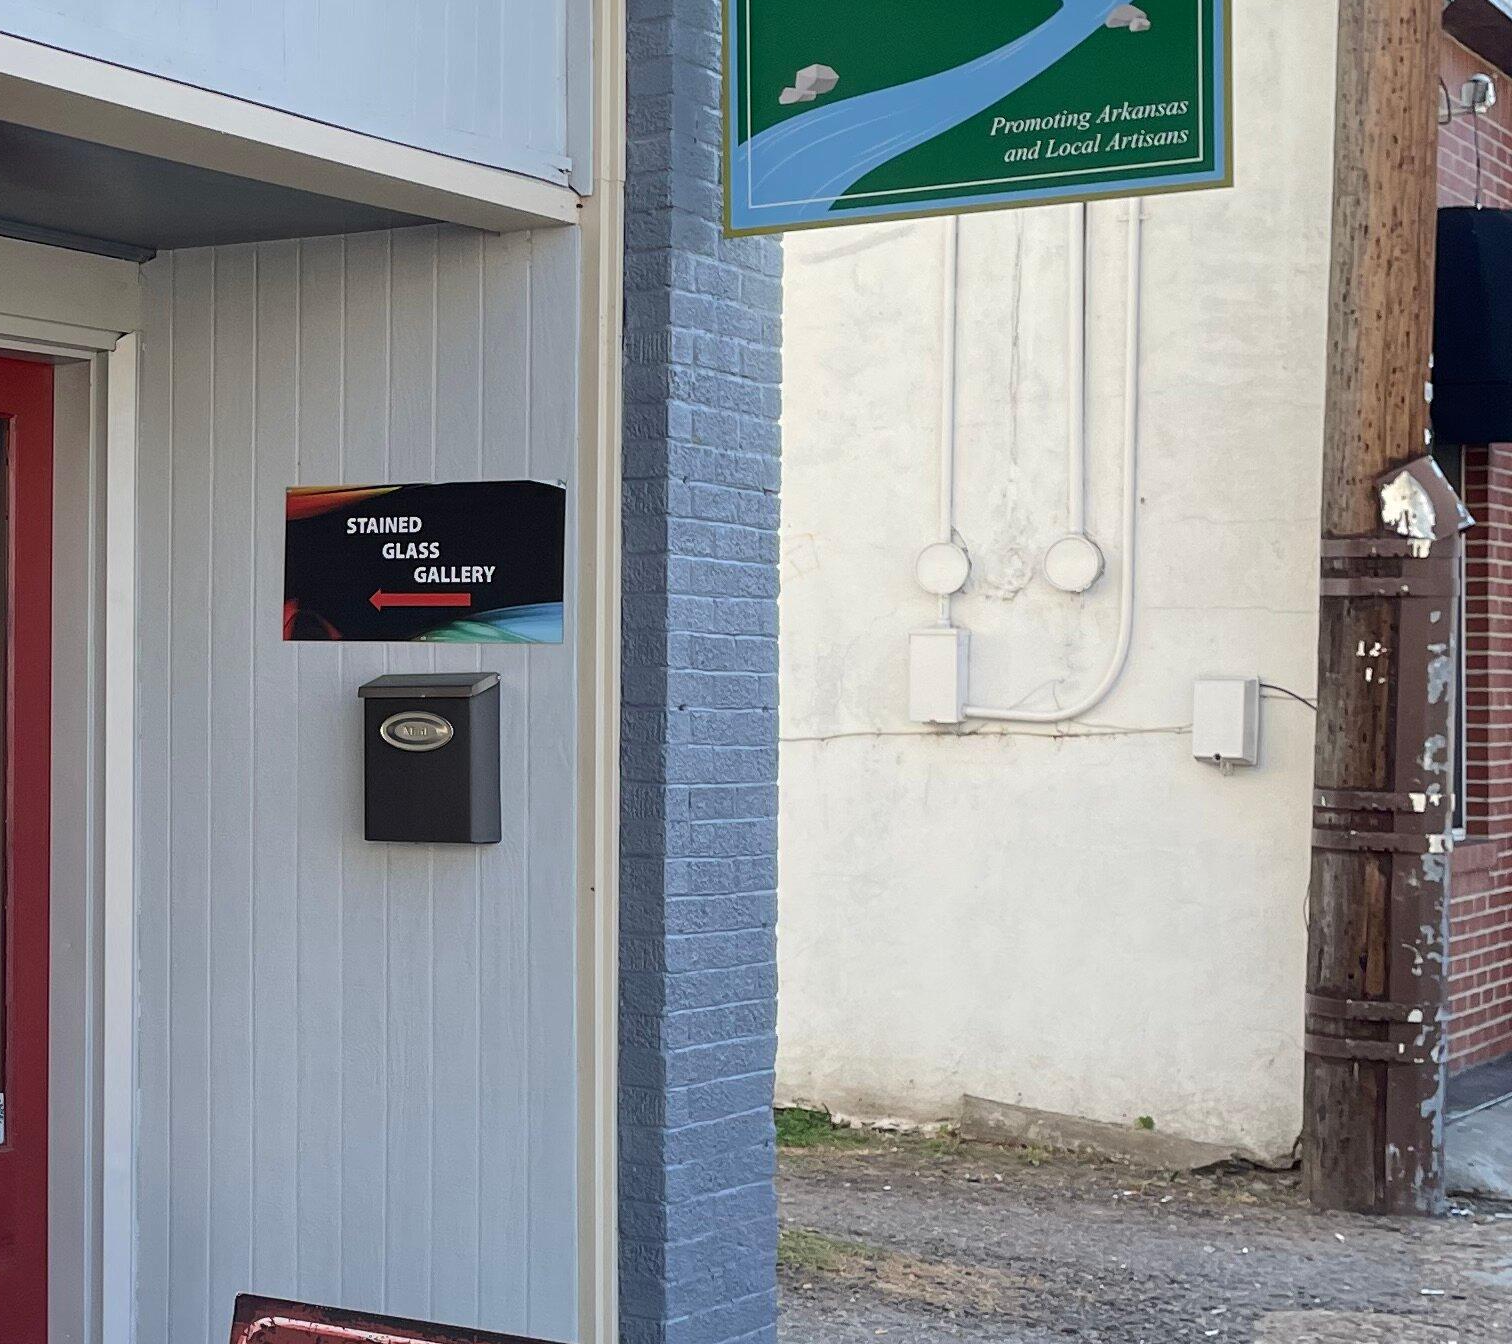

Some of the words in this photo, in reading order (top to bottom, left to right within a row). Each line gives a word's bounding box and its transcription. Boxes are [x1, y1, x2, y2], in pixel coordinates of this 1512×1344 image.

[990, 110, 1091, 137] Promoting
[1096, 99, 1189, 123] Arkansas
[1004, 140, 1039, 162] and
[1046, 133, 1100, 157] Local
[1105, 127, 1189, 151] Artisans
[346, 516, 423, 534] STAINED
[382, 541, 440, 560] GLASS
[413, 565, 496, 584] GALLERY
